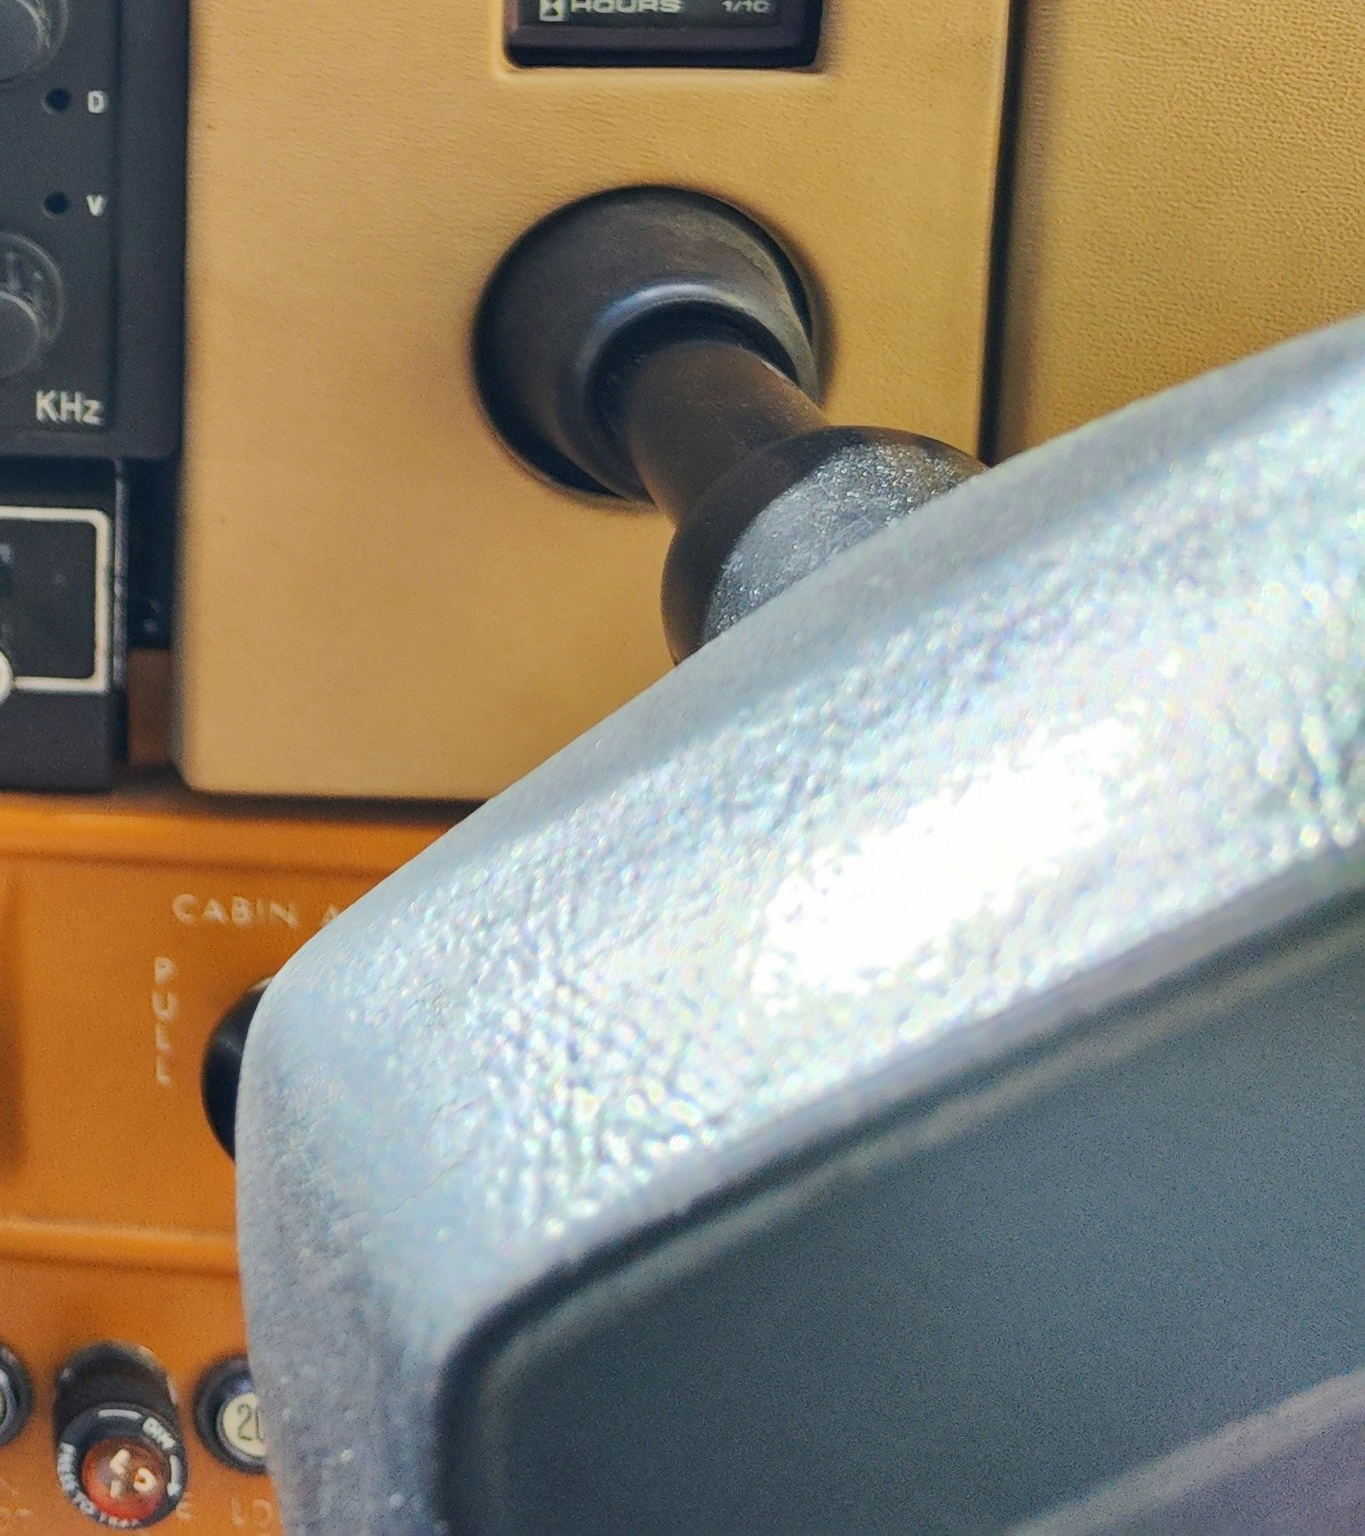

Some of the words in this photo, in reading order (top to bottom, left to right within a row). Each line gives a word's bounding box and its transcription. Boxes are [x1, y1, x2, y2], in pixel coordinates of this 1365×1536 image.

[35, 389, 105, 425] KHz
[171, 892, 302, 930] CABIN
[151, 955, 180, 1087] PULL
